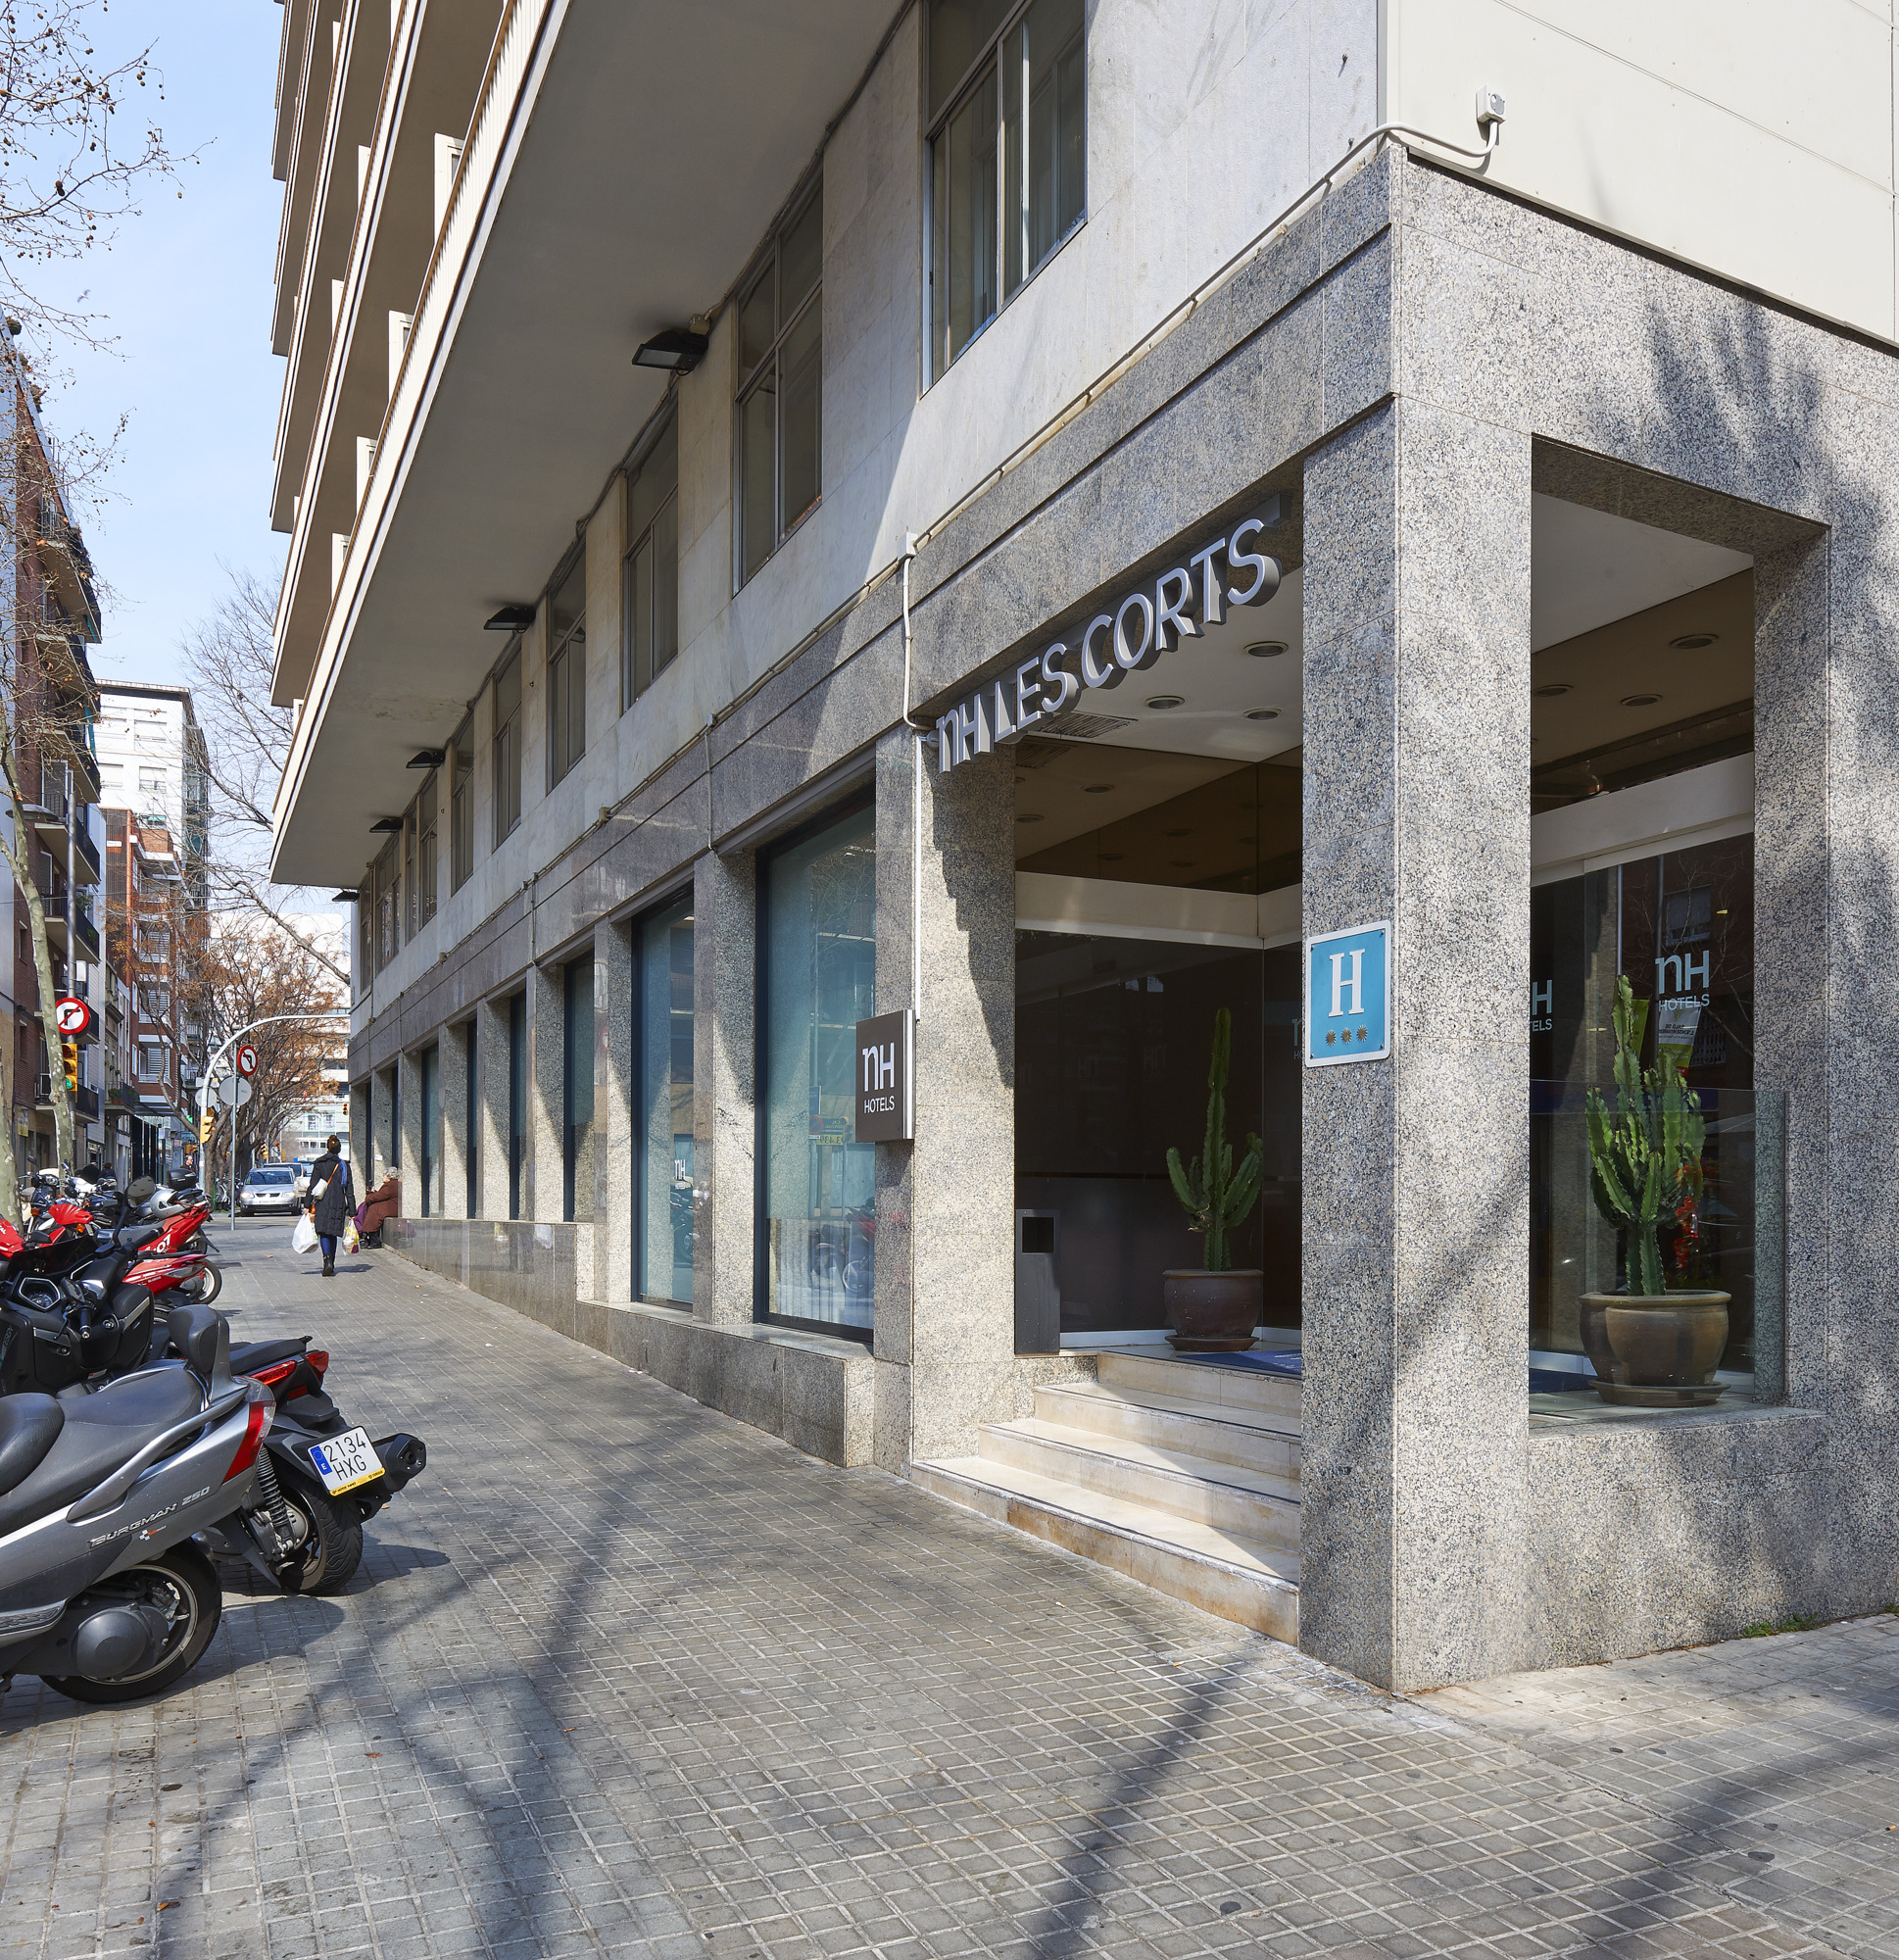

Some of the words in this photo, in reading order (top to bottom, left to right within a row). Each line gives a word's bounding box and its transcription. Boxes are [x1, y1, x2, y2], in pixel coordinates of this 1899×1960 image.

[995, 642, 1080, 743] LES
[1081, 517, 1276, 689] CORTS
[1328, 948, 1366, 1018] H
[1658, 993, 1710, 1012] HOTELS
[863, 1095, 896, 1114] HOTELS
[323, 1432, 366, 1463] 2134
[332, 1454, 367, 1481] HXG
[88, 1502, 177, 1548] BURGMAN
[181, 1486, 211, 1506] 250
